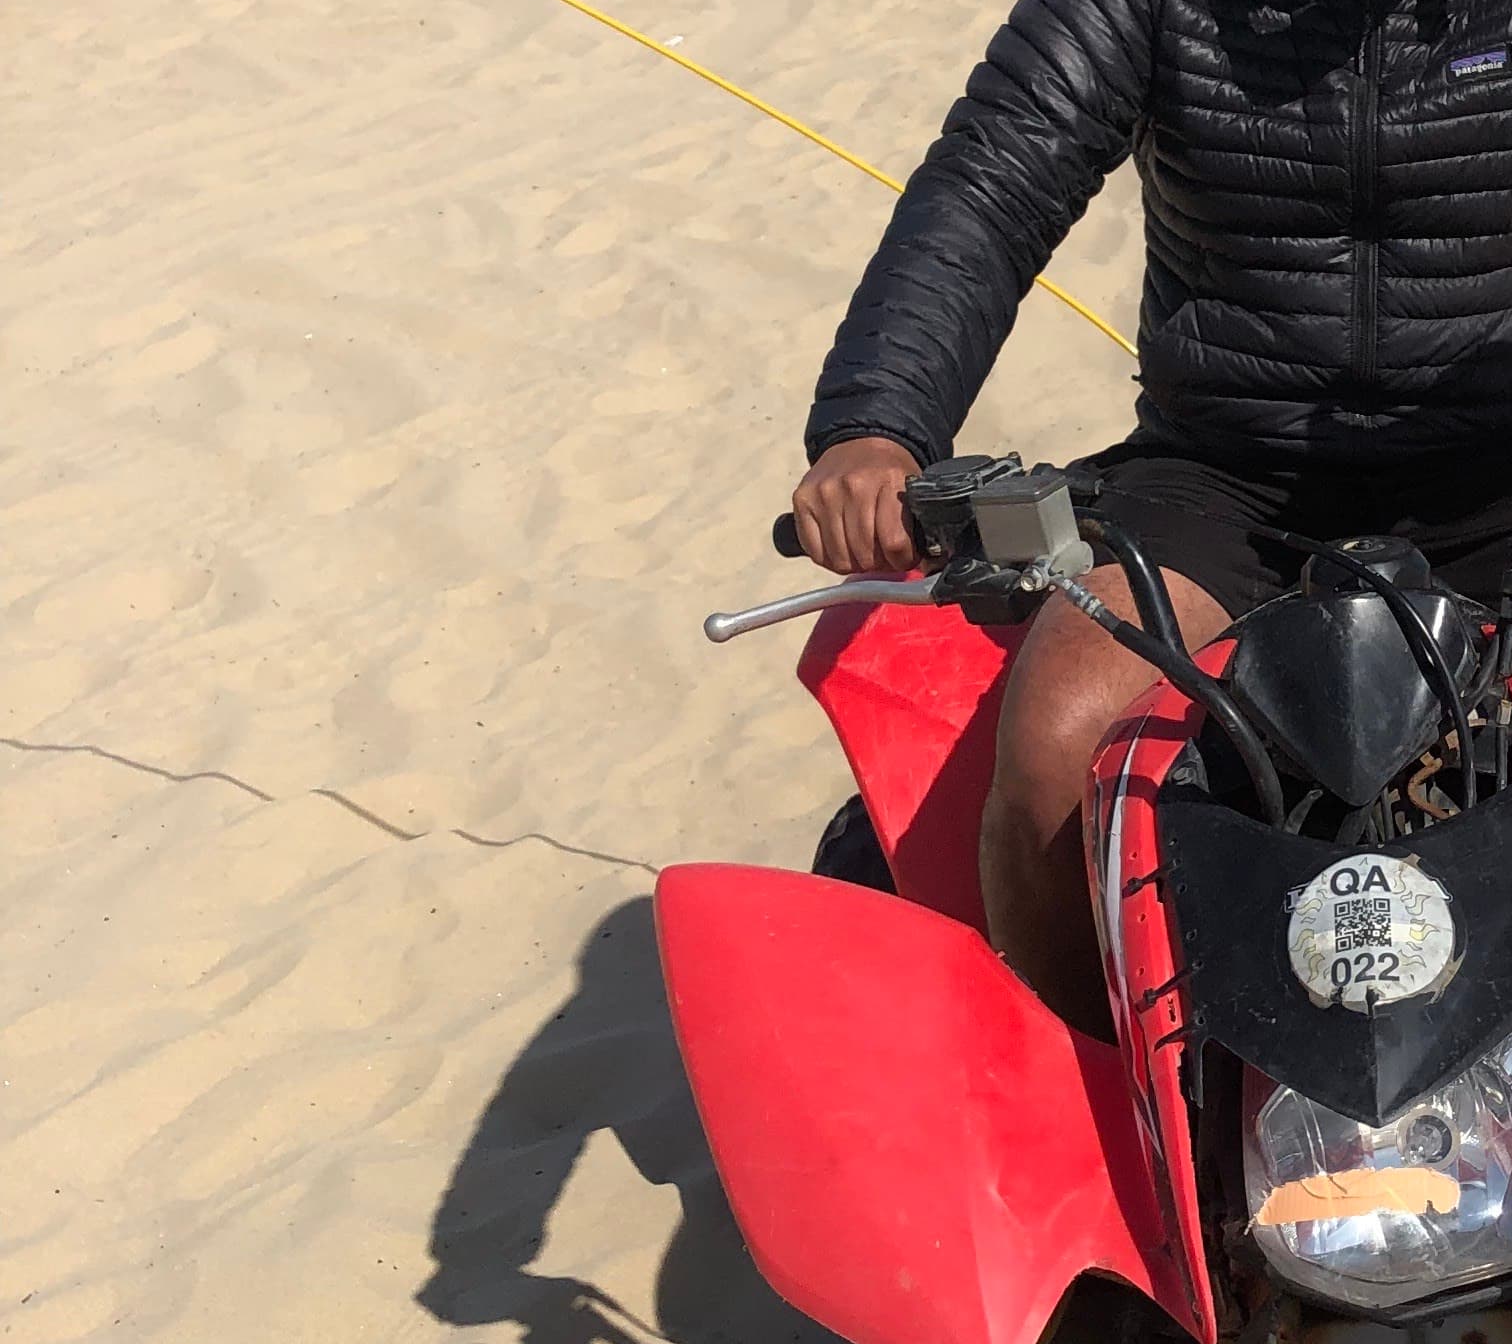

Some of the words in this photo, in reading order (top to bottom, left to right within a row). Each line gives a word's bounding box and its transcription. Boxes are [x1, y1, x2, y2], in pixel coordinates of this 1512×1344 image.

[1455, 61, 1503, 76] patagonia
[1330, 865, 1392, 896] QA
[1331, 952, 1400, 987] 022
